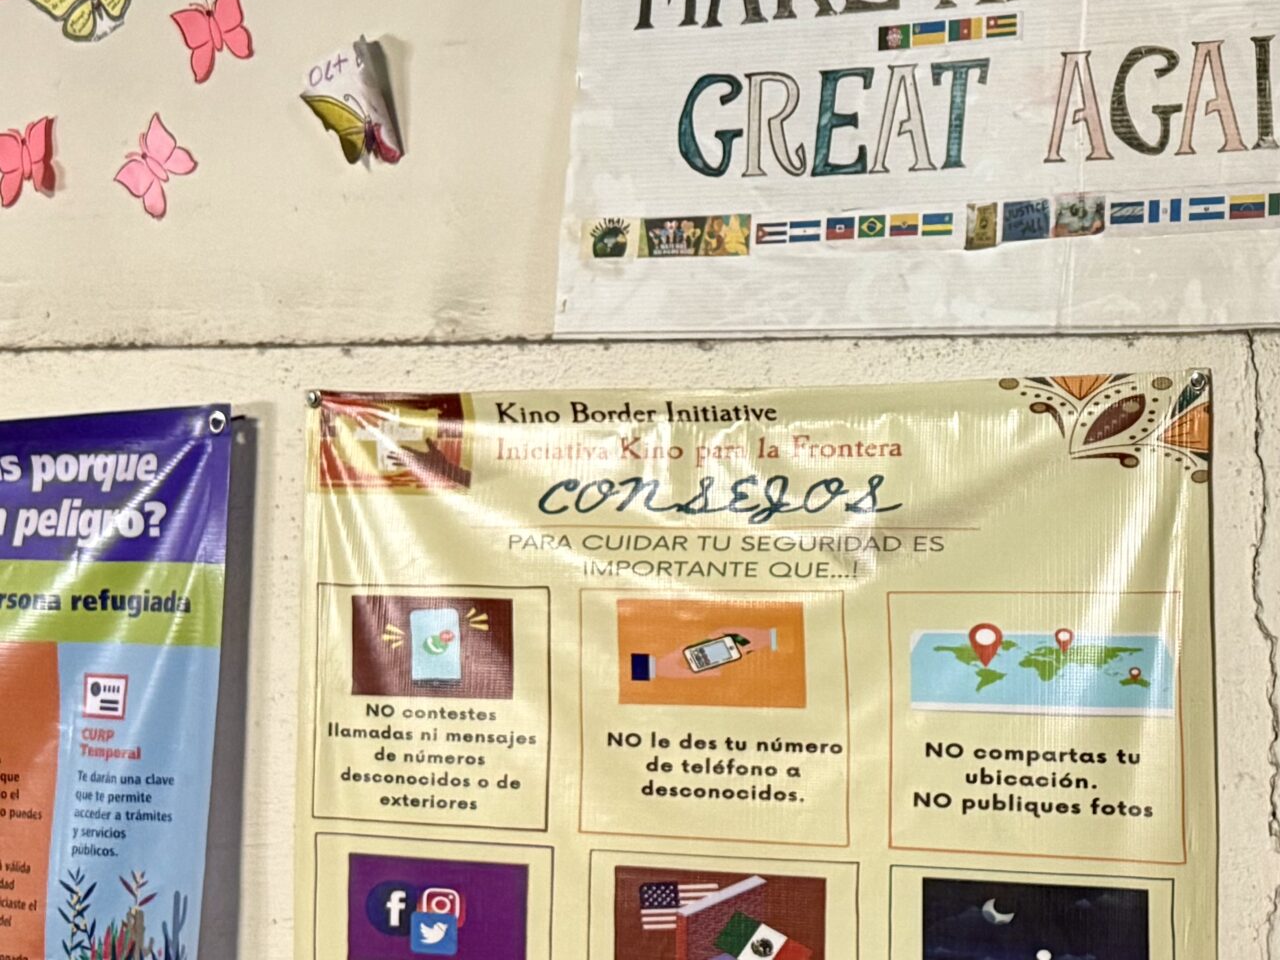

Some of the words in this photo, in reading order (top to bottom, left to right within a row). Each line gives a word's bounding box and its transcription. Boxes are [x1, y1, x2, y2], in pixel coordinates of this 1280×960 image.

[678, 58, 990, 179] GREAT
[495, 402, 560, 423] Kino
[571, 401, 656, 423] Border
[666, 401, 778, 423] Initiative
[496, 438, 608, 460] Iniciativa
[620, 437, 684, 460] Kino
[695, 443, 746, 468] para
[758, 437, 779, 459] la
[792, 435, 903, 459] Frontera
[30, 453, 157, 492] porque
[12, 498, 167, 549] peligro?
[508, 534, 572, 551] PARA
[582, 534, 688, 552] CUIDAR
[697, 535, 731, 551] TU
[741, 535, 901, 553] SEGURIDAD
[913, 535, 945, 553] ES
[583, 560, 758, 578] IMPORTANTE
[769, 561, 858, 579] QUE...!
[71, 589, 191, 617] refugiada
[366, 703, 395, 718] NO
[402, 706, 497, 721] contestes
[81, 728, 115, 741] CURP
[328, 722, 413, 741] llamadas
[421, 728, 438, 741] ni
[446, 731, 537, 749] mensajes
[606, 732, 642, 748] NO
[651, 731, 671, 749] le
[679, 733, 717, 750] des
[725, 737, 747, 751] tu
[757, 737, 843, 754] número
[80, 744, 141, 761] Temporal
[374, 746, 396, 762] de
[403, 749, 486, 765] números
[925, 742, 964, 758] NO
[973, 747, 1107, 766] compartas
[1117, 749, 1141, 764] tu
[646, 756, 673, 773] de
[682, 758, 778, 776] teléfono
[786, 767, 801, 778] a
[77, 770, 88, 782] Te
[90, 770, 117, 784] darán
[120, 775, 141, 785] una
[145, 773, 175, 786] clave
[340, 766, 471, 788] desconocidos
[478, 778, 489, 788] o
[496, 774, 521, 790] de
[965, 767, 1098, 789] ubicación.
[10, 788, 19, 800] el
[75, 790, 93, 803] que
[95, 791, 105, 802] te
[107, 790, 152, 804] permite
[641, 779, 805, 803] desconocidos.
[380, 794, 478, 810] exteriores
[914, 792, 952, 808] NO
[962, 793, 1081, 818] publiques
[1090, 797, 1153, 817] fotos
[9, 808, 42, 820] puedes
[74, 807, 111, 820] acceder
[114, 811, 121, 820] a
[125, 807, 173, 822] trámites
[72, 827, 79, 839] y
[81, 826, 126, 839] servicios
[71, 844, 119, 858] públicos.
[5, 861, 31, 874] válida
[28, 899, 37, 911] el
